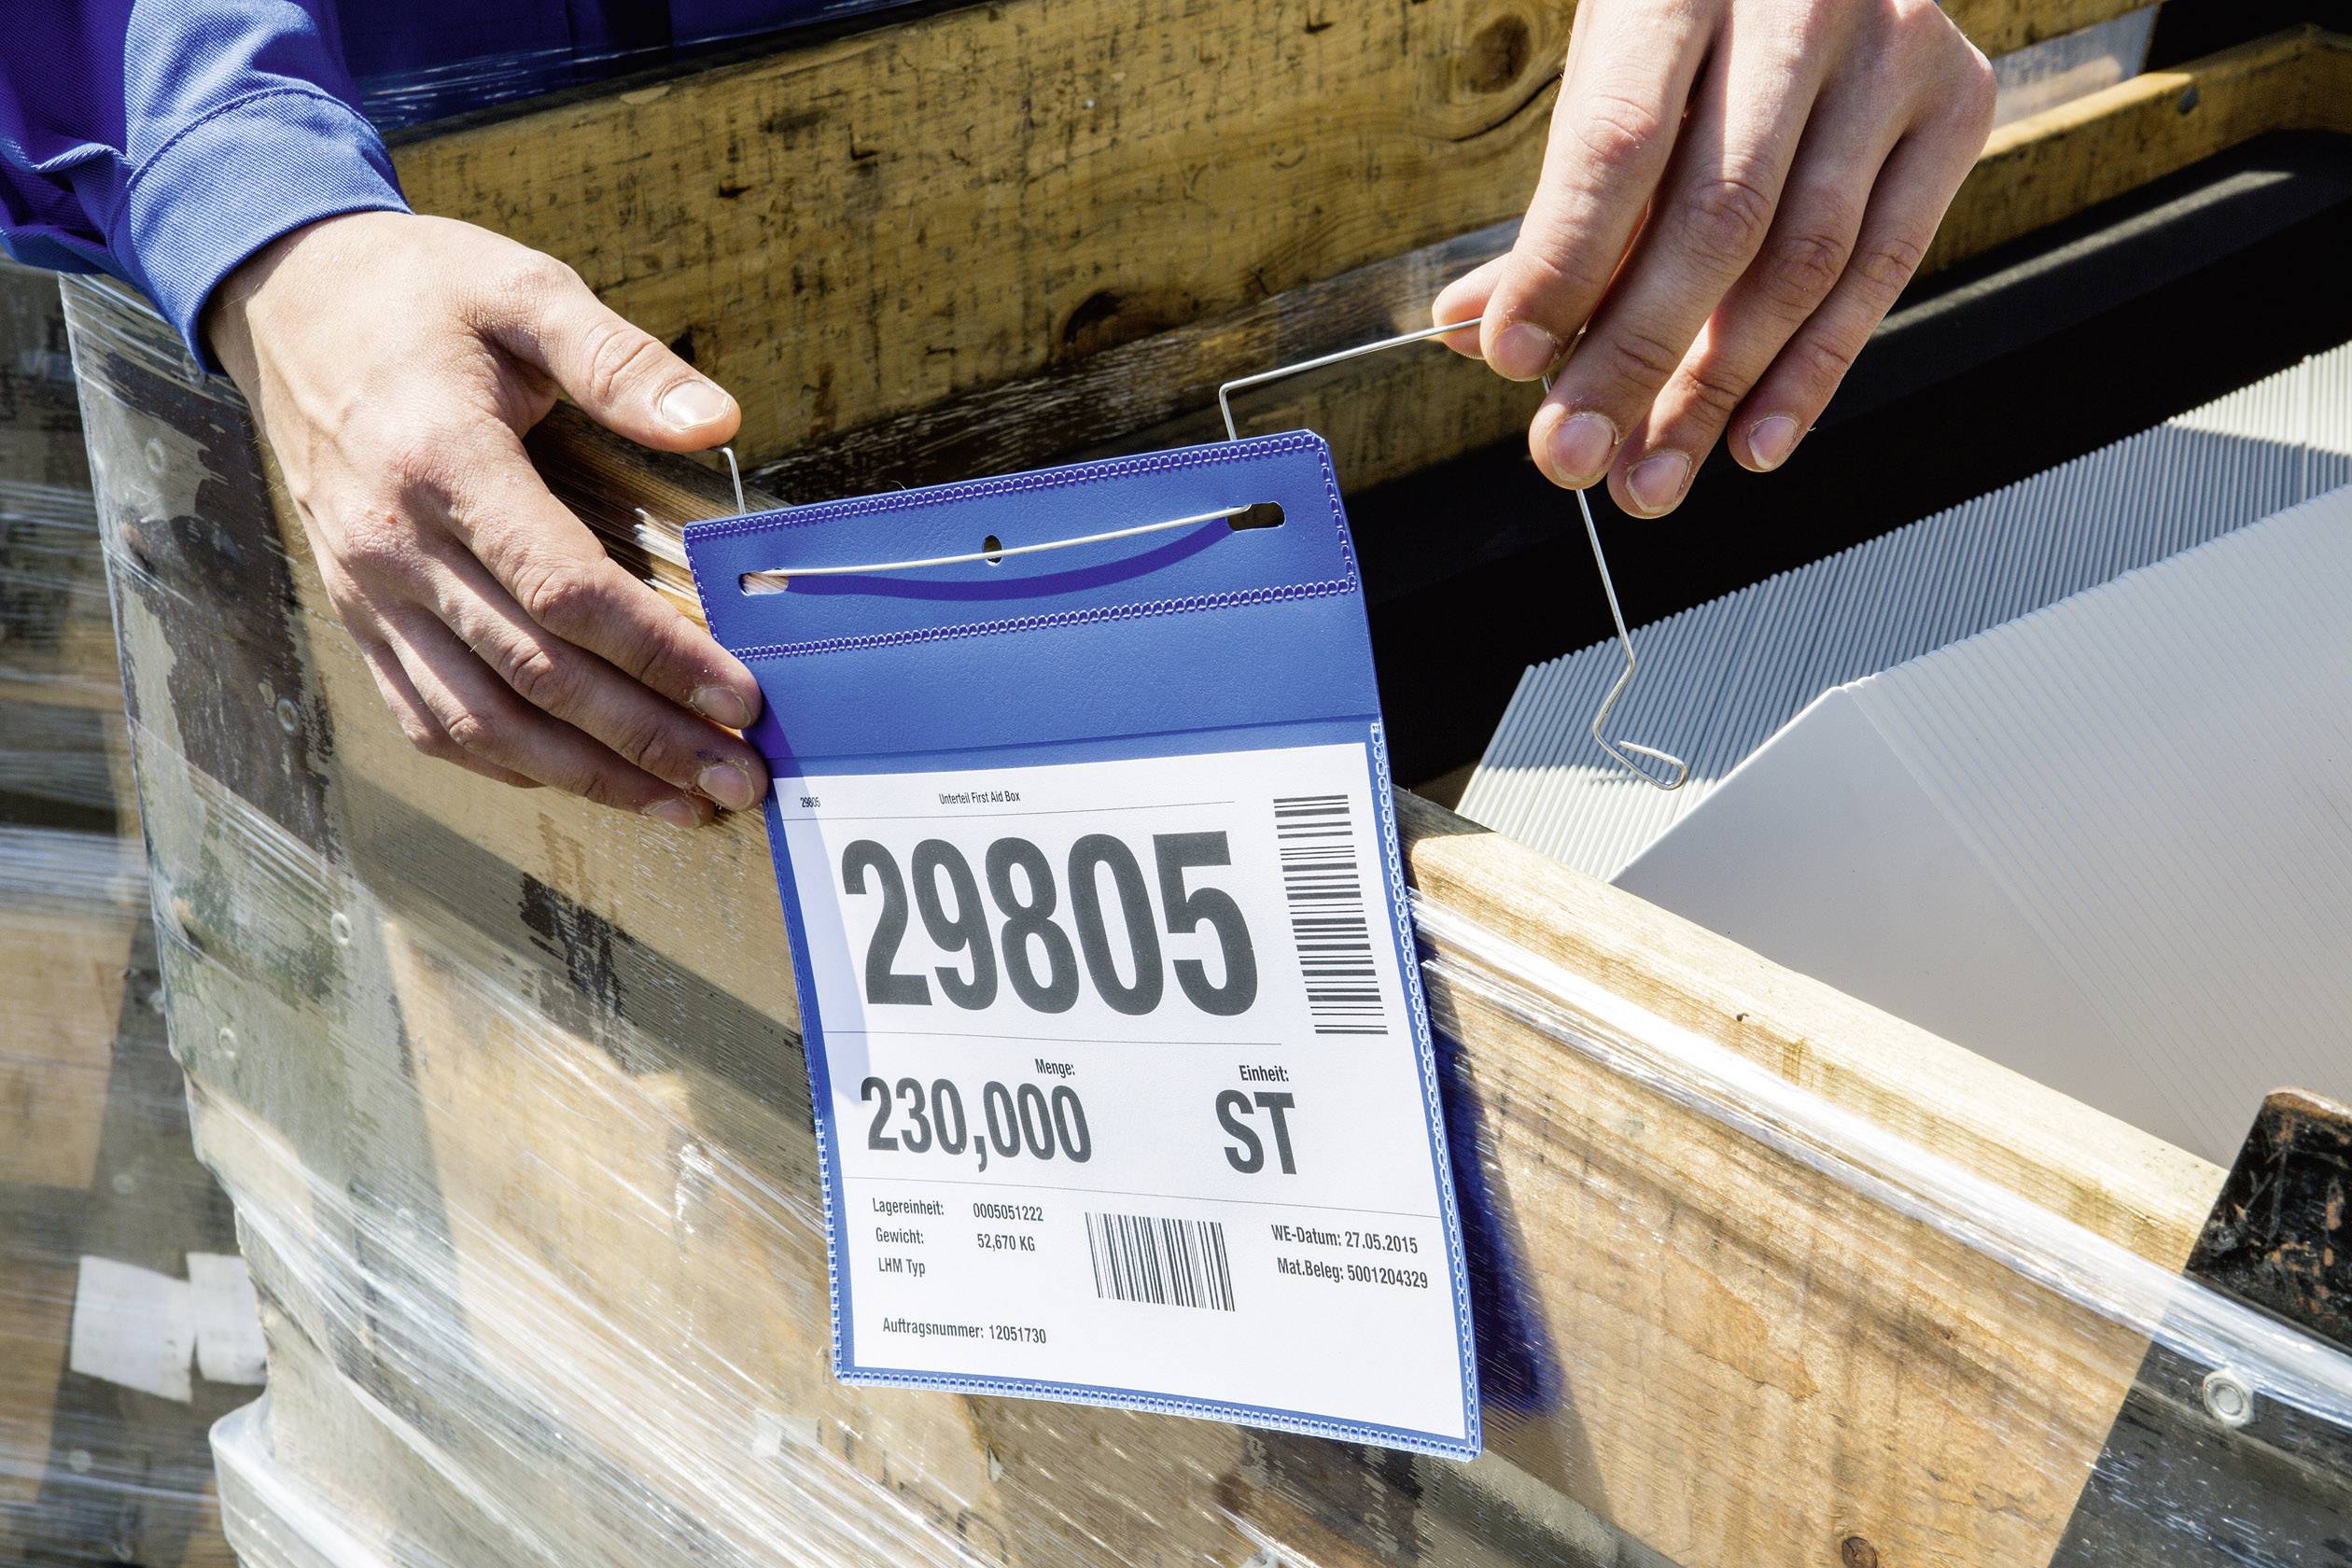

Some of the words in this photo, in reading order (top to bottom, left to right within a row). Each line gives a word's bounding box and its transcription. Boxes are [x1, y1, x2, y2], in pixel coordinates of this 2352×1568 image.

[799, 796, 821, 808] 29805
[938, 791, 971, 805] Unterteil
[971, 791, 989, 804] First
[990, 791, 1004, 803] Aid
[1004, 790, 1021, 803] Box
[841, 830, 1258, 1016] 29805
[1034, 1058, 1075, 1079] Menge:
[1239, 1064, 1290, 1083] Einheit:
[860, 1076, 1092, 1173] 230,000
[1215, 1089, 1297, 1175] ST
[872, 1197, 945, 1217] Lagereinheit:
[973, 1202, 1044, 1222] 0005051222
[875, 1226, 924, 1245] Gewicht:
[976, 1233, 1016, 1252] 52,670
[1018, 1235, 1036, 1253] KG
[1270, 1224, 1341, 1247] WE-Datum:
[1344, 1230, 1418, 1254] 27.05.2015
[878, 1257, 903, 1273] LHM
[905, 1258, 926, 1278] Typ
[1277, 1257, 1344, 1283] Mat.Beleg:
[1347, 1264, 1428, 1289] 5001204329
[883, 1317, 984, 1338] Auftragsnummer:
[988, 1324, 1047, 1344] 12051730
